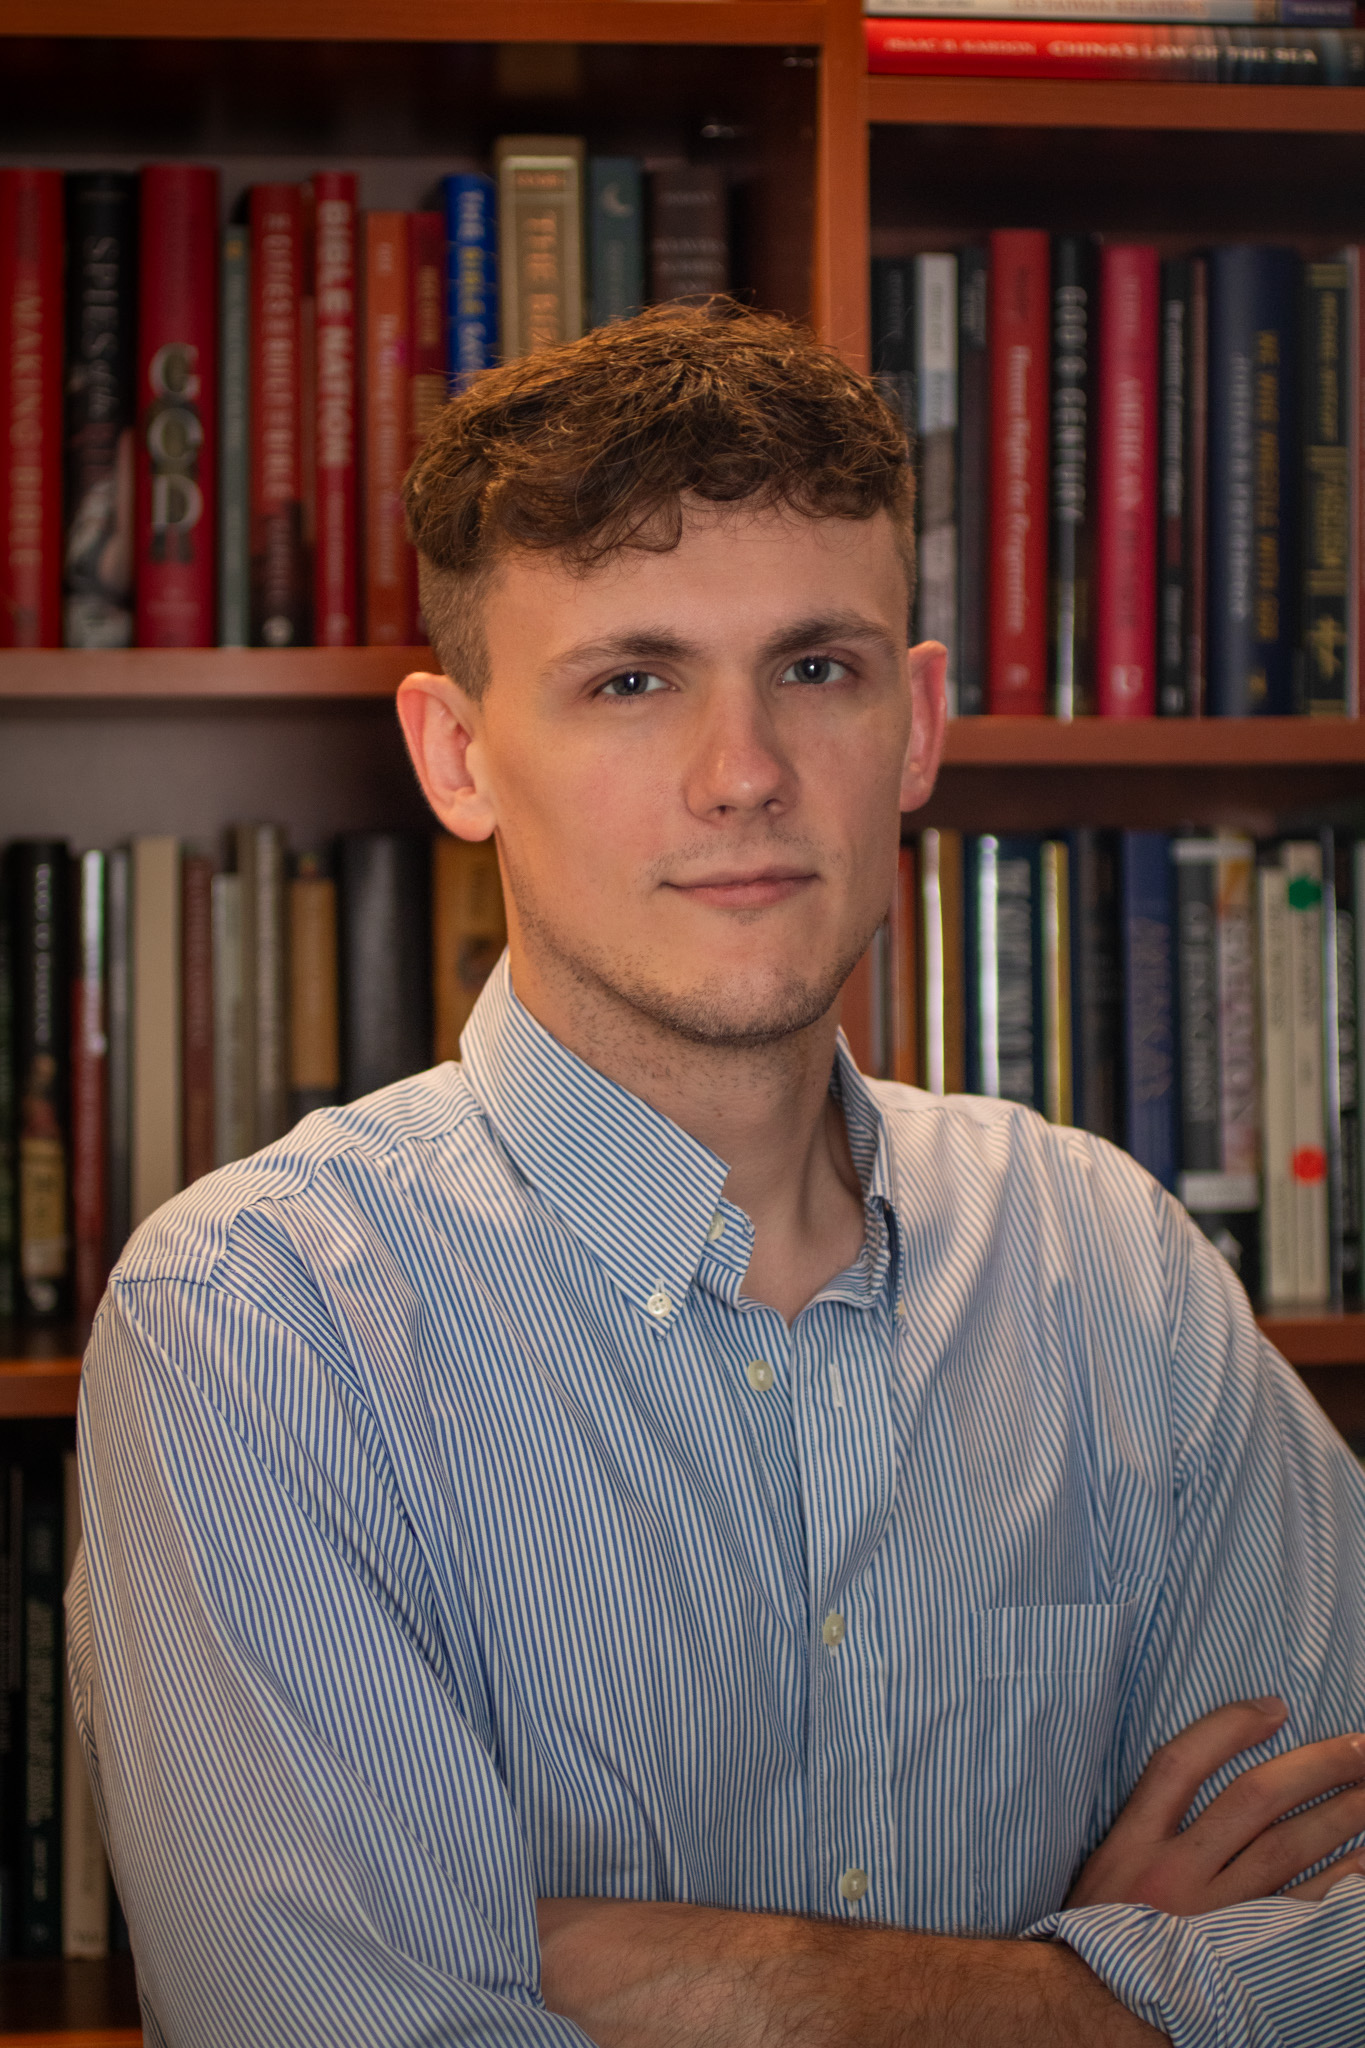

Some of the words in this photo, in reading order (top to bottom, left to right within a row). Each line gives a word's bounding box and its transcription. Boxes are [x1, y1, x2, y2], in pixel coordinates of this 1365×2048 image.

[1143, 43, 1187, 61] LAW
[1190, 44, 1219, 61] OF
[1226, 45, 1268, 64] THE
[1273, 47, 1318, 65] SEA
[318, 199, 354, 314] BIBLE
[460, 188, 486, 240] THE
[525, 217, 558, 281] THE
[82, 236, 120, 358] SPIES
[10, 293, 43, 447] MAKING
[318, 325, 353, 468] NATION
